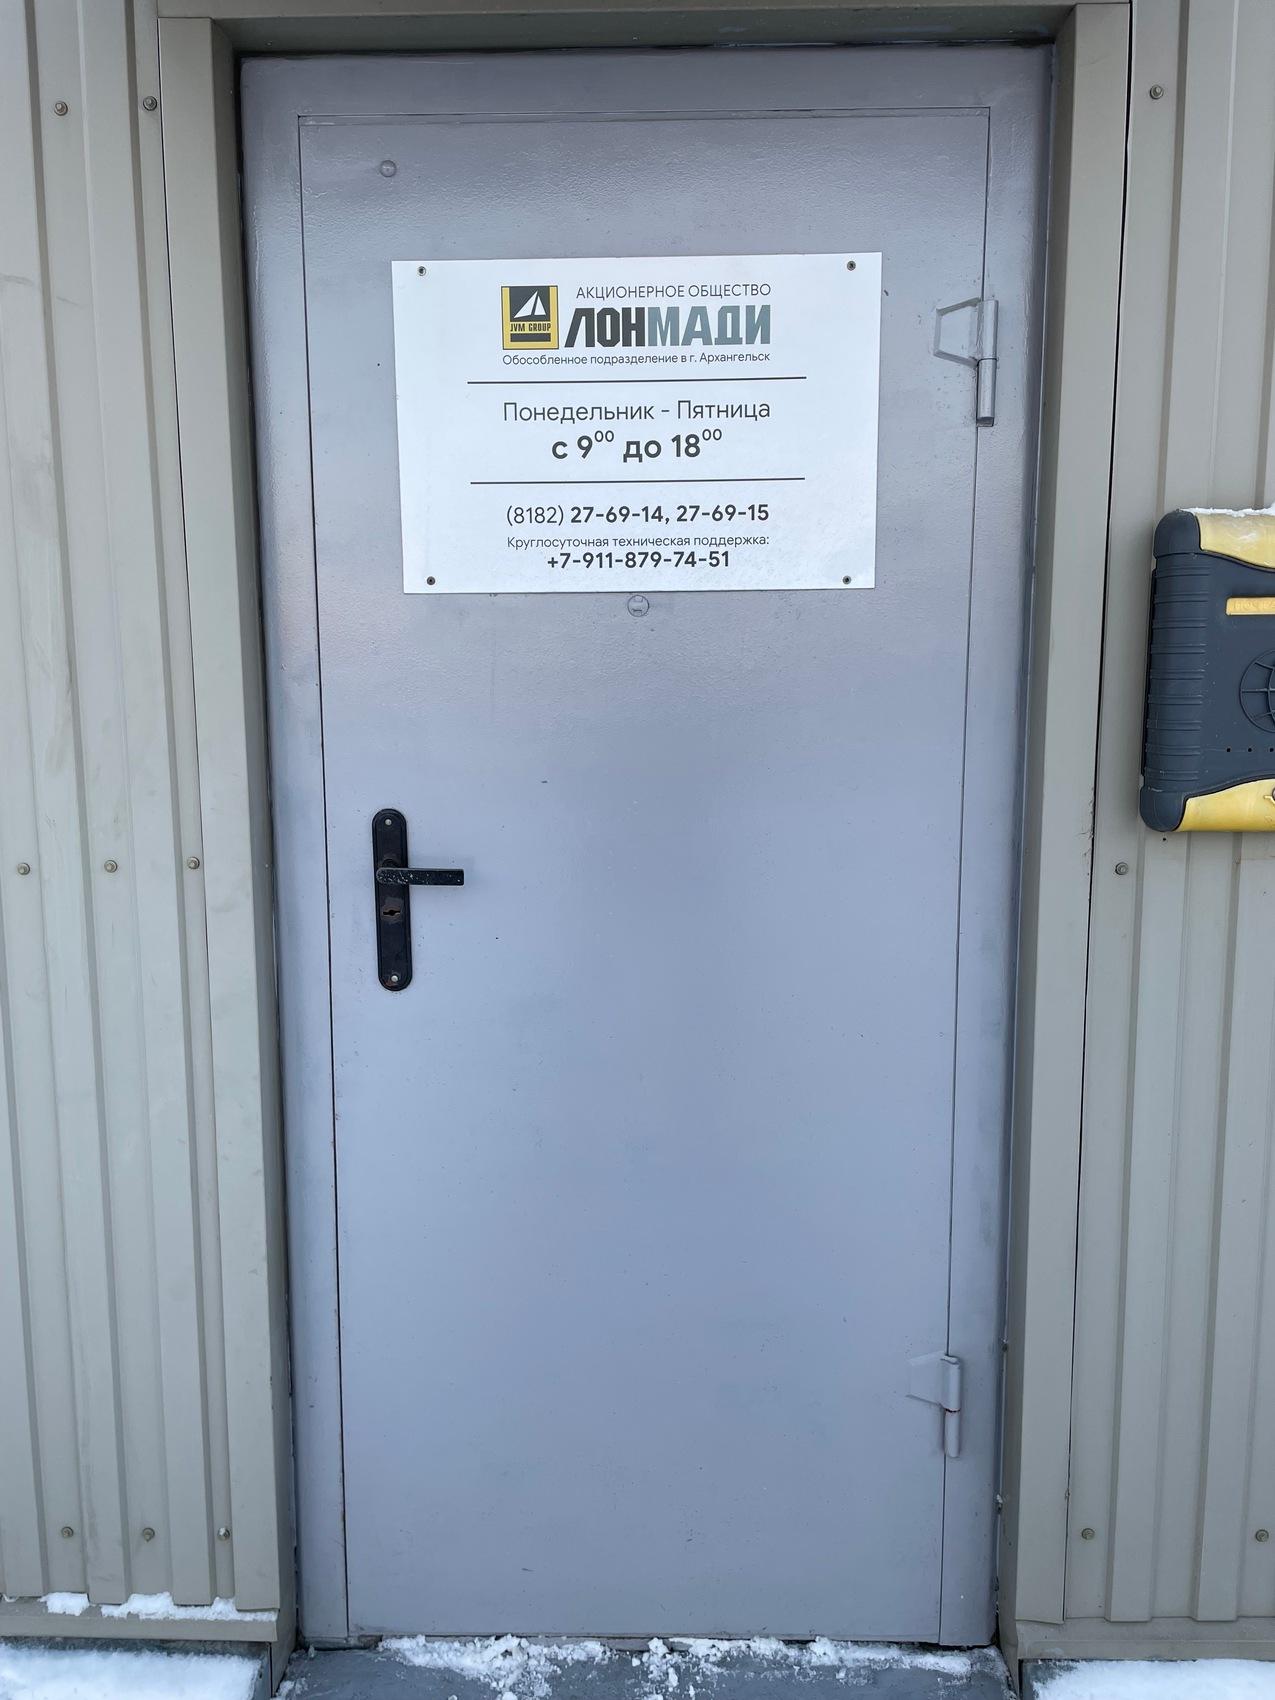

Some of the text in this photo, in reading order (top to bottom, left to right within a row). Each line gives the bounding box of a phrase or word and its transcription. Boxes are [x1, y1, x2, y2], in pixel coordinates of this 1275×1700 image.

[576, 284, 771, 301] АКЦИОНЕРНОЕ ОБЩЕСТВО
[510, 322, 552, 333] JVM GROUP
[564, 305, 770, 348] ЛОНМАДИ
[503, 355, 587, 365] Обособленное
[591, 355, 678, 366] подразделение
[700, 352, 770, 364] Архангельск
[504, 402, 654, 424] Понедельник
[678, 400, 770, 421] Пятница
[623, 440, 661, 463] до
[507, 504, 769, 526] (8182) 27-69-14, 27-69-15
[508, 536, 769, 550] Круглосуточная техническая поддержка:
[548, 551, 728, 568] +7-911-879-74-51
